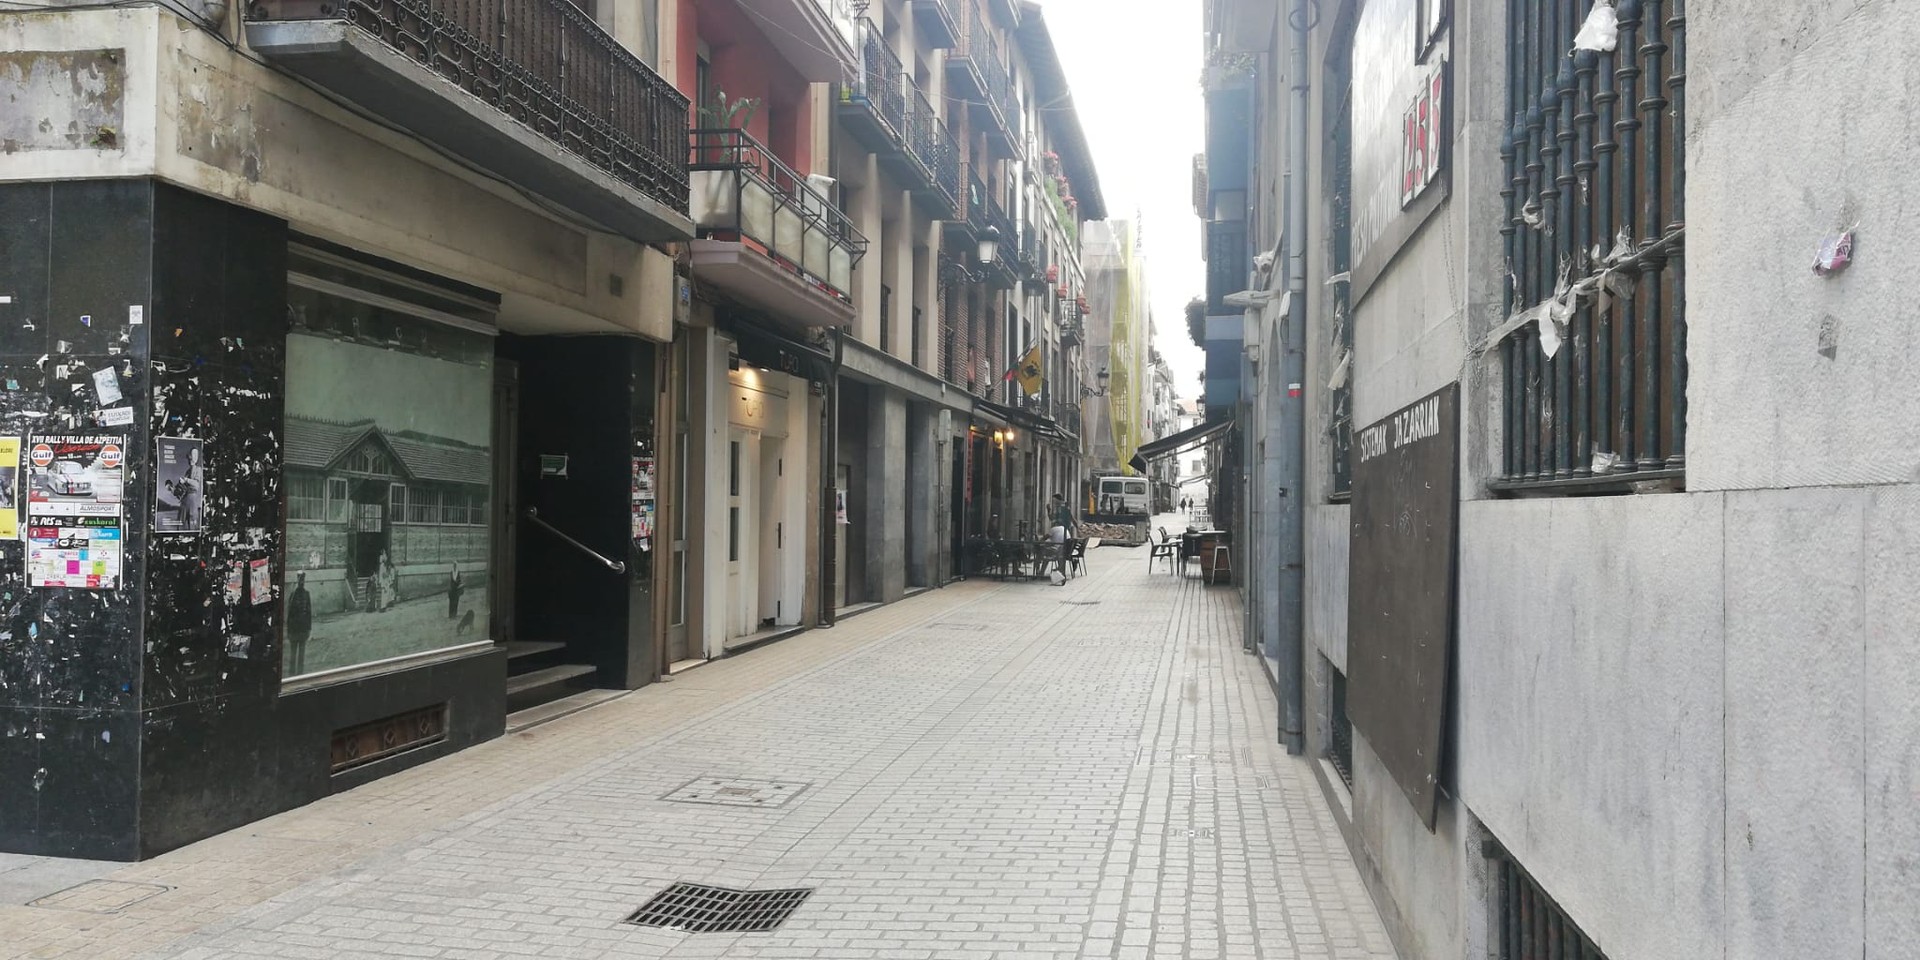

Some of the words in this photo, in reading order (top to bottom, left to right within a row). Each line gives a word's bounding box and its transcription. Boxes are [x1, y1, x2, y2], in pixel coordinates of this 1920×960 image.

[1394, 395, 1439, 449] JAZARRIAK
[45, 435, 65, 444] RALLY
[66, 435, 84, 444] VILLA
[85, 436, 94, 444] DE
[94, 436, 122, 445] AZPEITIA
[32, 451, 52, 459] Gulf
